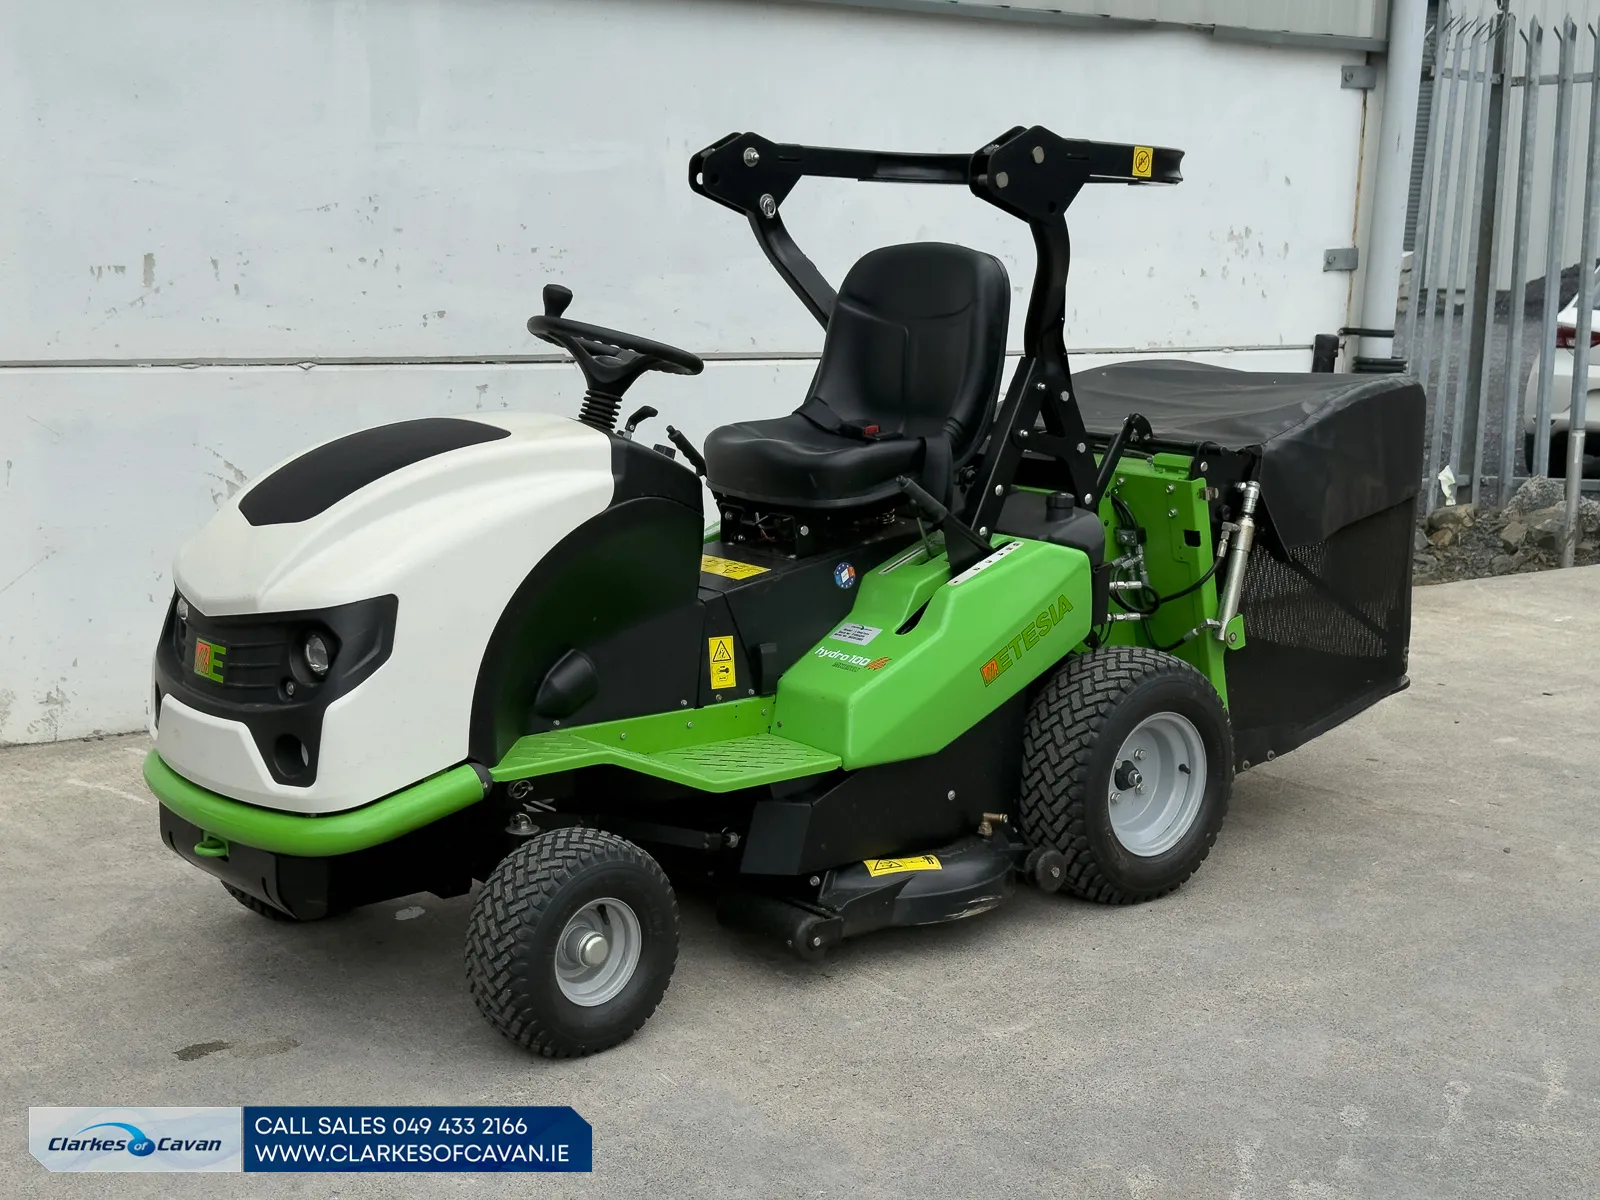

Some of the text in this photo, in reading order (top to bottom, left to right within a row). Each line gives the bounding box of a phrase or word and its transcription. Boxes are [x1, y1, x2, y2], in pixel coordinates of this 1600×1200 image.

[815, 646, 871, 666] hydro 100
[980, 594, 1074, 688] ETESIA
